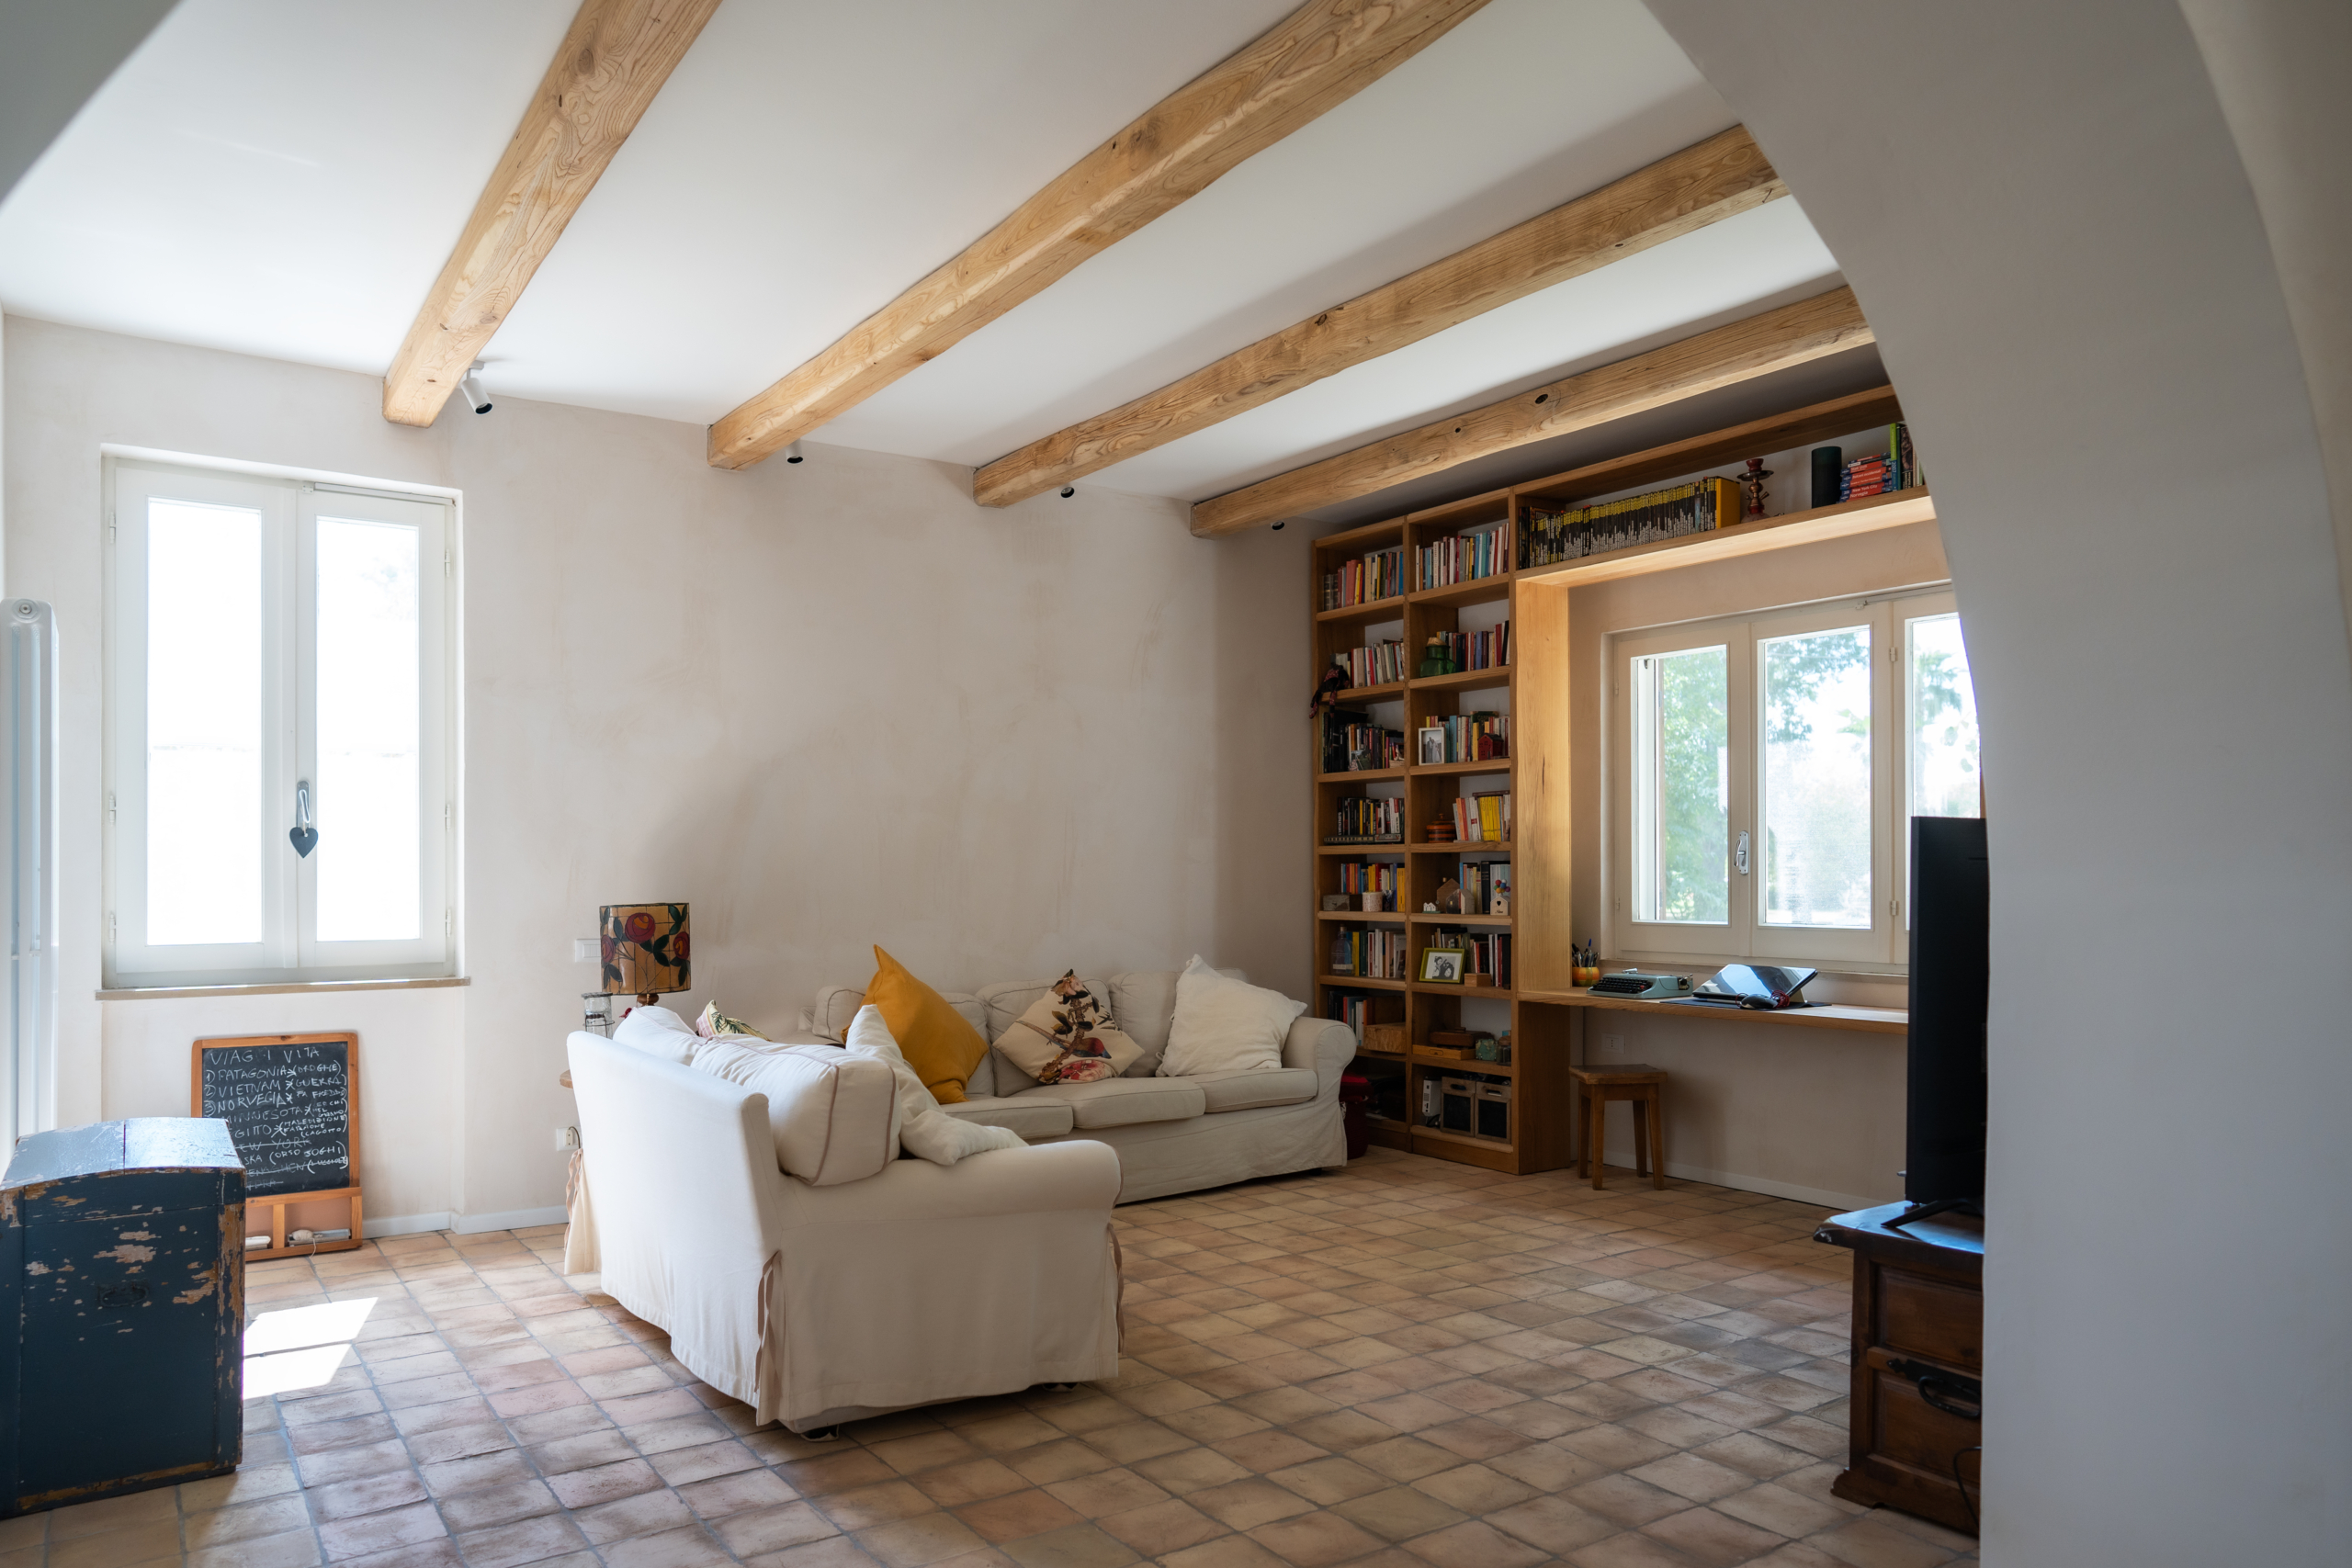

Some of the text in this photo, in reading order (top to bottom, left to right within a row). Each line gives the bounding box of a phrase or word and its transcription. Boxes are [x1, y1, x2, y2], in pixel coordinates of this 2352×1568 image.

[283, 1047, 320, 1064] VITA
[218, 1066, 287, 1081] PATAGONIA
[219, 1079, 281, 1099] VIETNAM
[218, 1090, 288, 1114] NORVEGIA
[271, 1137, 312, 1150] YORK
[243, 1154, 263, 1166] SKA
